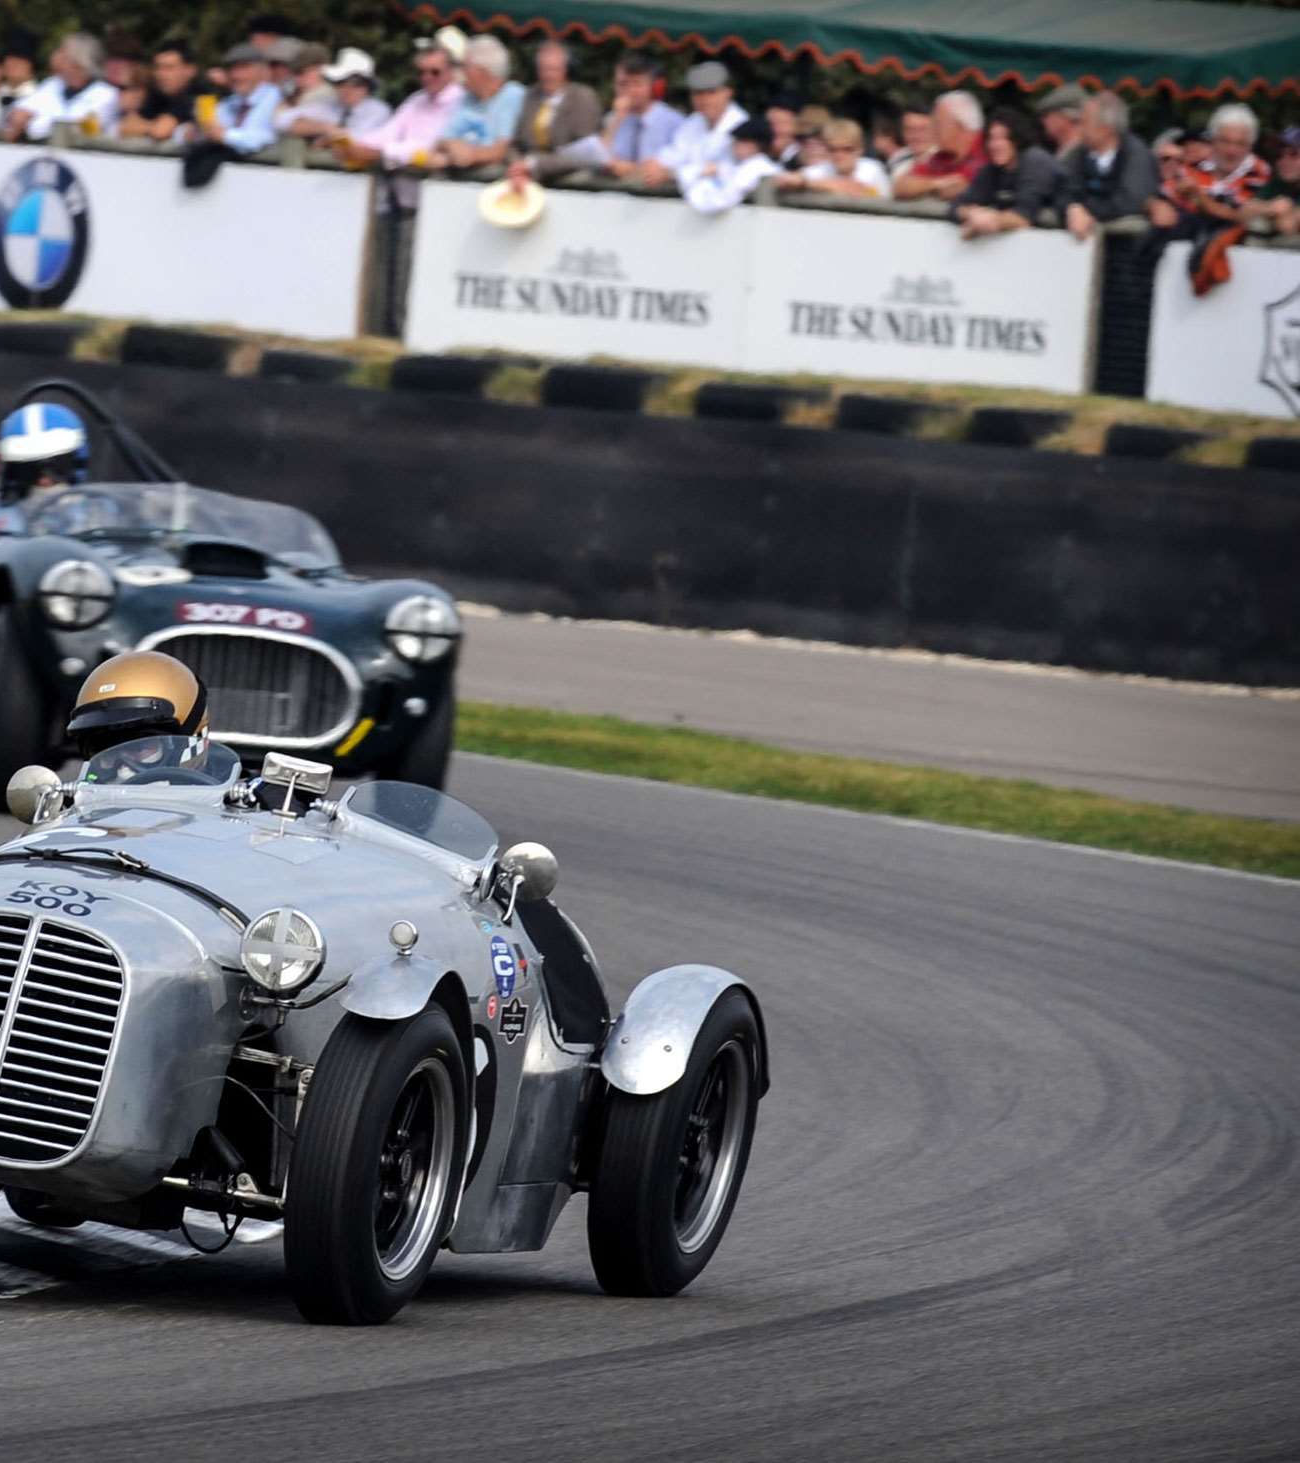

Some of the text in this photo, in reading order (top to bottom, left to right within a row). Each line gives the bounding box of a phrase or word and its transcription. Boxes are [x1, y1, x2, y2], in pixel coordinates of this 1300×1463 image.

[456, 274, 709, 326] THE SUNDAY TIMES
[790, 299, 1047, 355] THE SUNDAY TIMES
[183, 602, 250, 622] 307
[5, 890, 92, 917] 500
[18, 880, 112, 904] KOY
